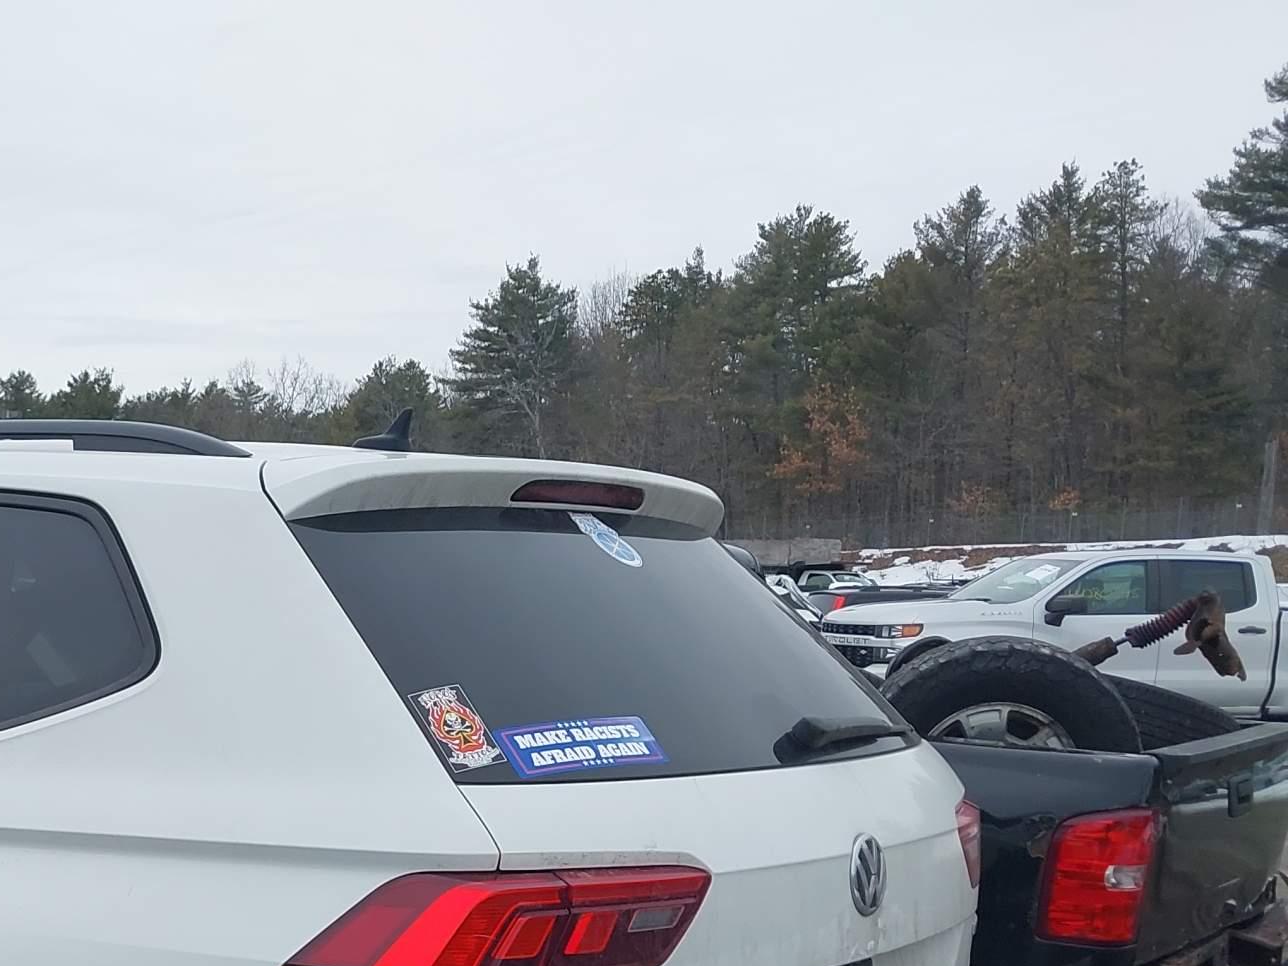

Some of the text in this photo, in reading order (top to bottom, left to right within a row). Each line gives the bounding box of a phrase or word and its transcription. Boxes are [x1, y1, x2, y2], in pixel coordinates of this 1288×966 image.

[514, 724, 641, 750] MAKE RACISTS
[530, 745, 598, 767] AFRAID
[597, 741, 651, 759] AGAIN
